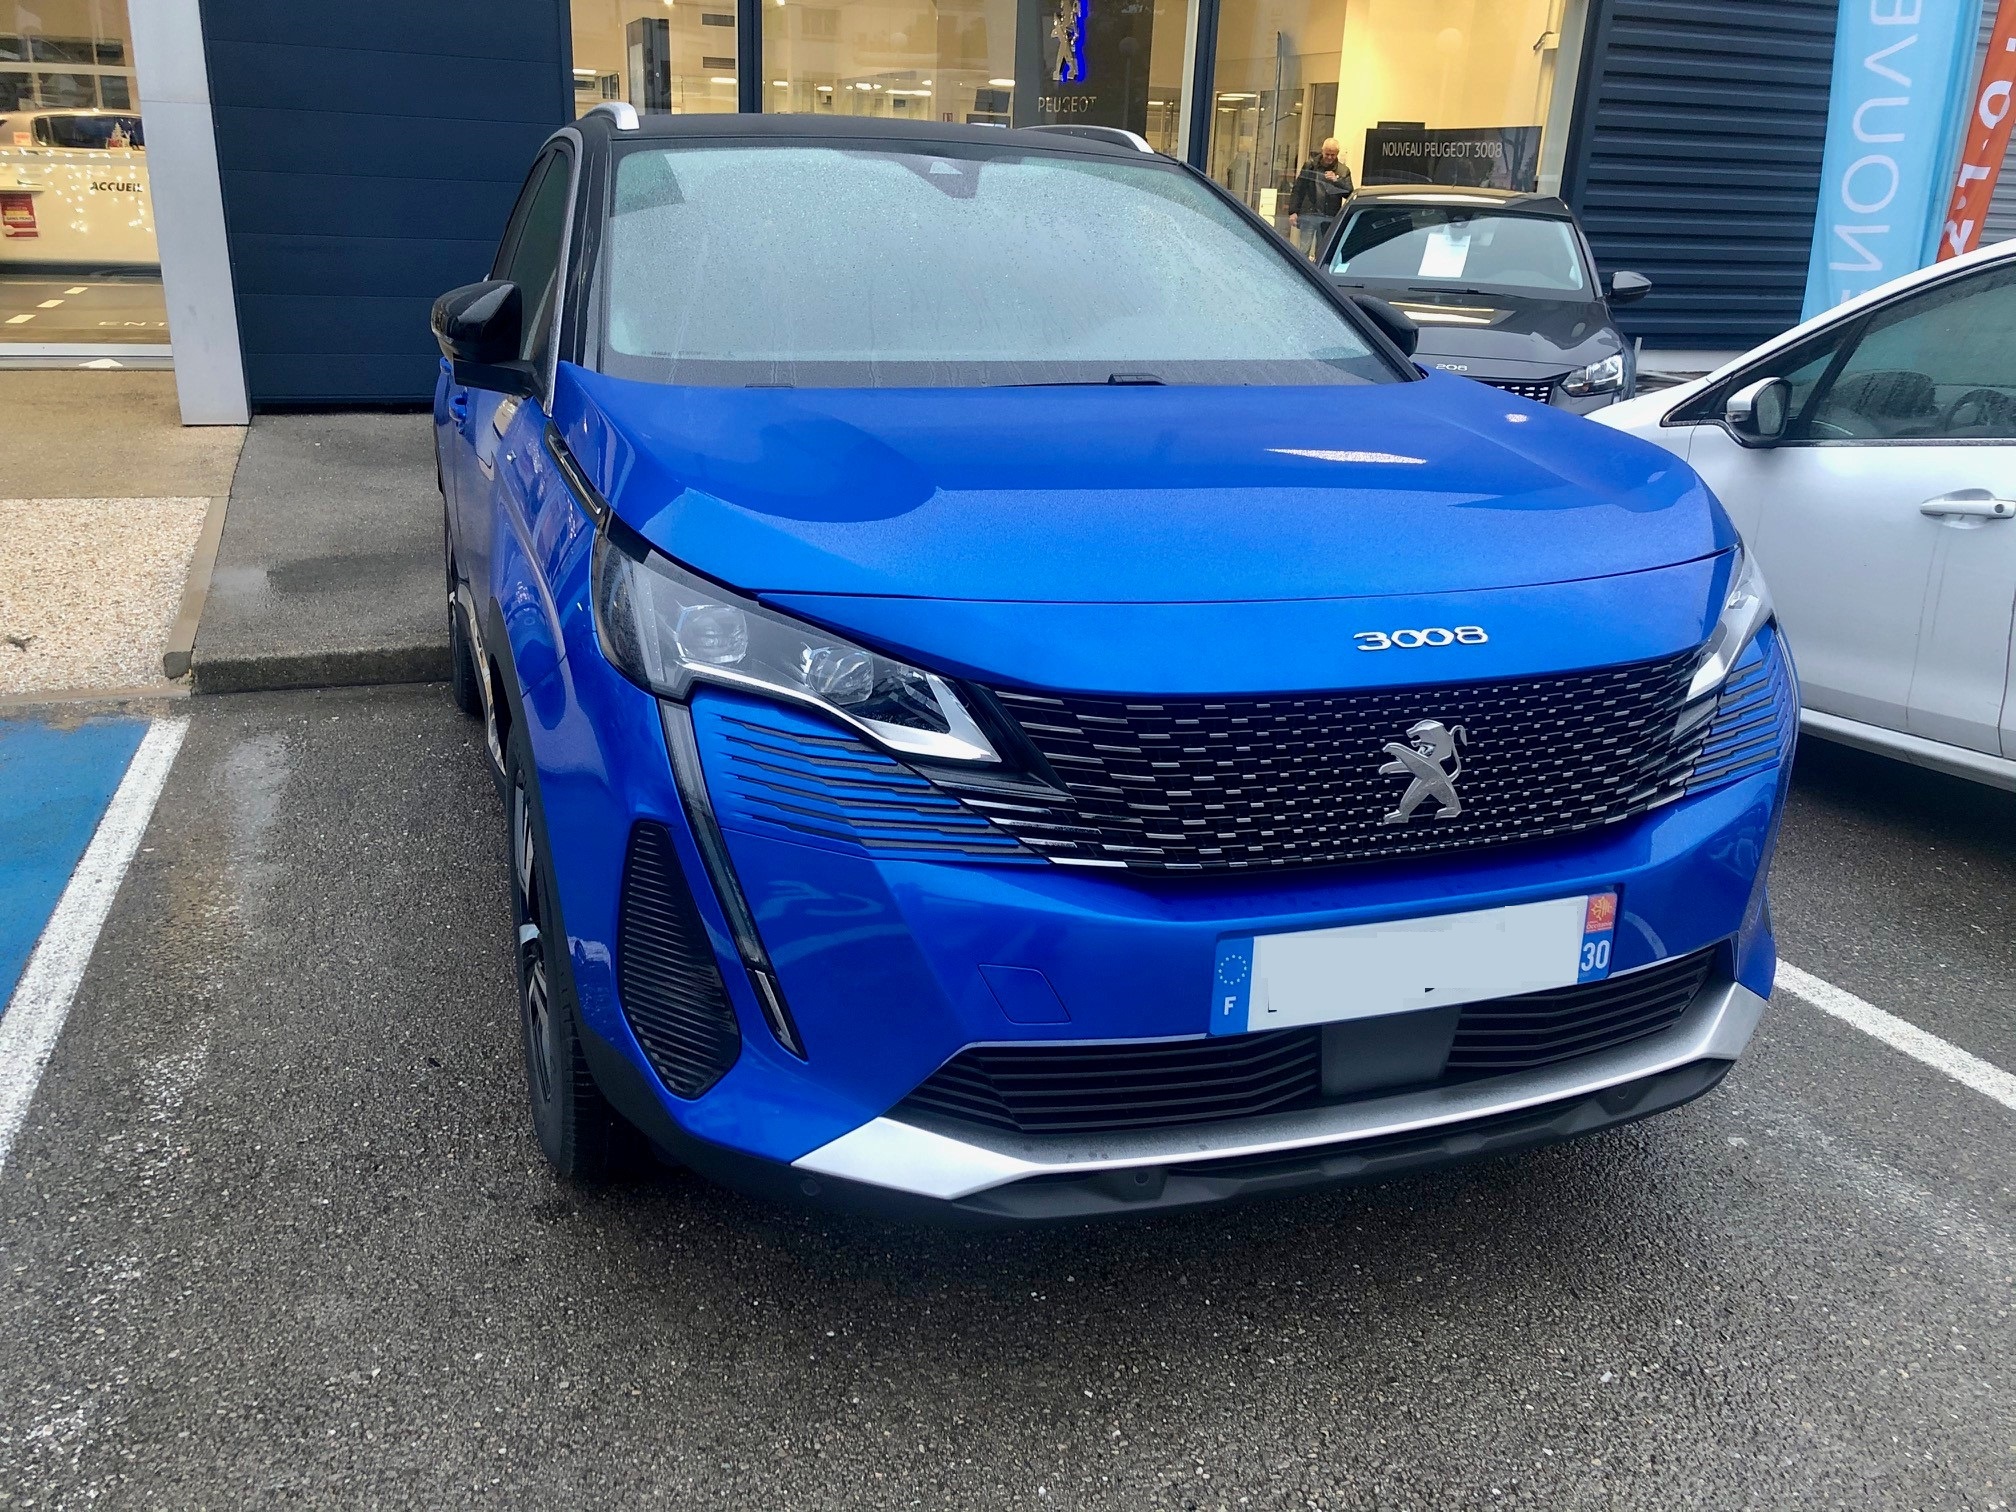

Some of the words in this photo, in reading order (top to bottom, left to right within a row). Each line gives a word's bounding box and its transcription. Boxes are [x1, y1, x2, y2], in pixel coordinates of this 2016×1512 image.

[1037, 96, 1097, 113] PEUGEOT
[1382, 142, 1422, 157] NOUVEAU
[1424, 142, 1471, 158] PEUGEOT
[1474, 142, 1503, 158] 3008
[90, 181, 143, 192] ACCUEIL
[1435, 363, 1468, 372] 208
[1353, 626, 1488, 651] 3008
[1581, 940, 1610, 971] 30
[1224, 996, 1237, 1015] F
